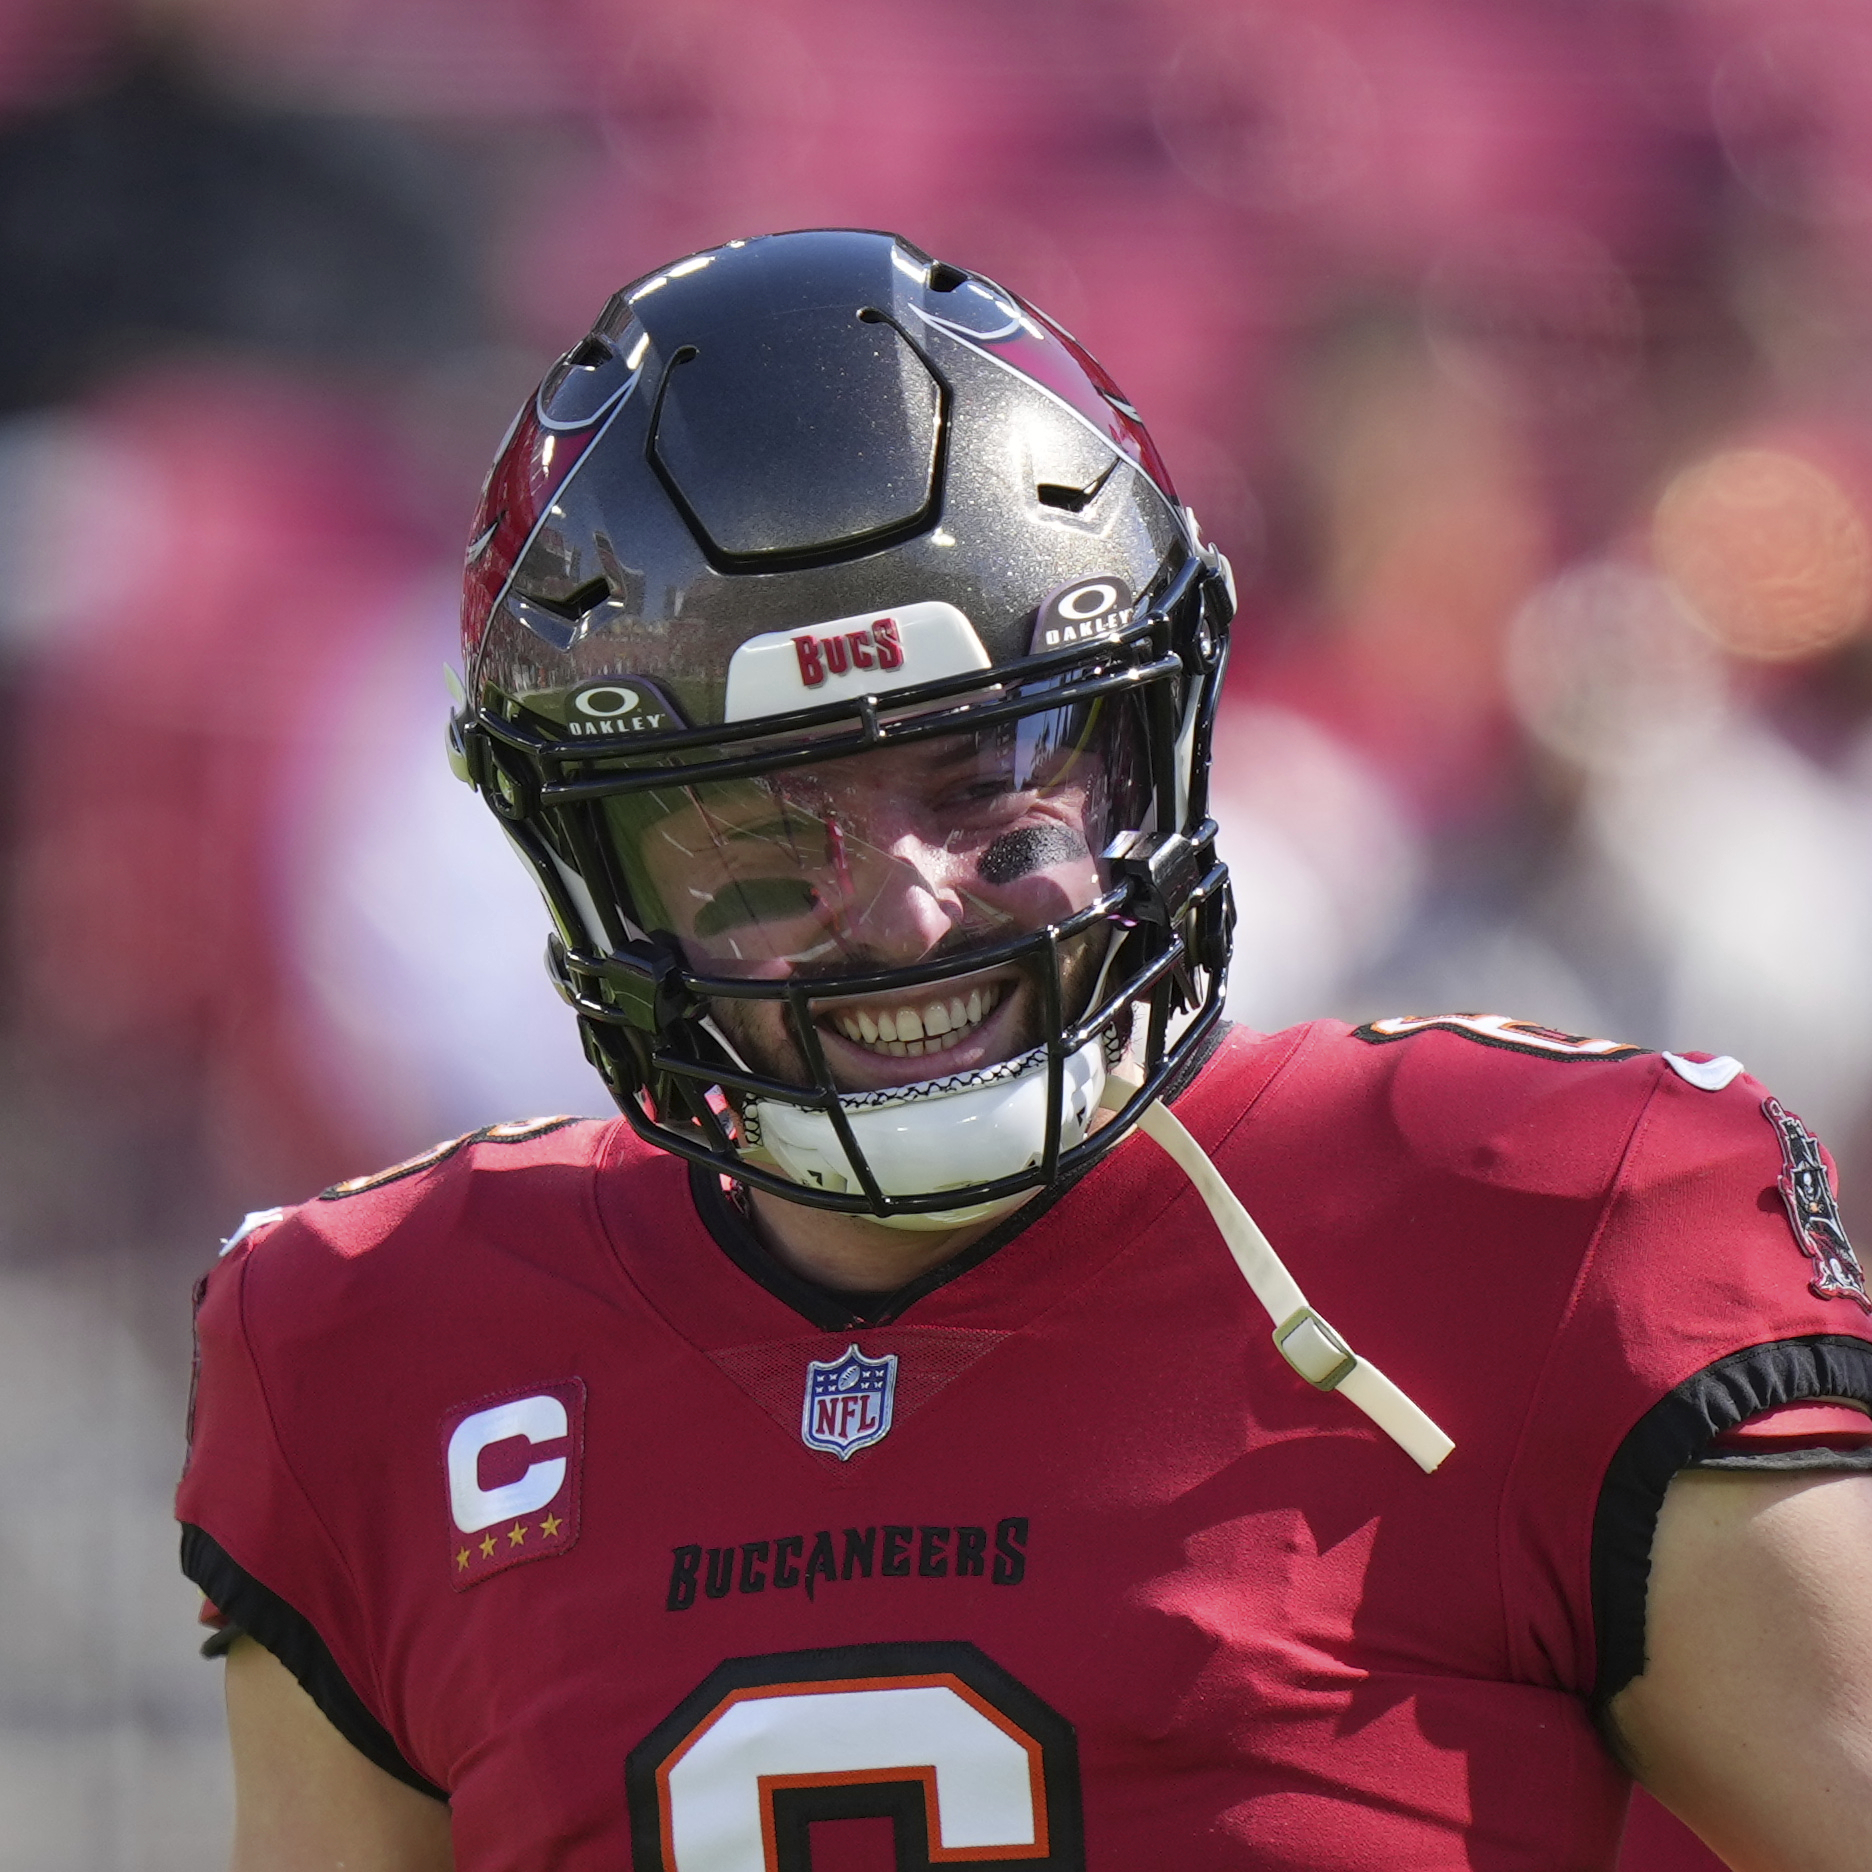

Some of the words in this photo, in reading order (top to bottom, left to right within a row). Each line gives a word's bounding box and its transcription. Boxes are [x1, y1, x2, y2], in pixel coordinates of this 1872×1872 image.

[791, 617, 905, 689] BUCS
[568, 713, 661, 736] OAKLEY
[815, 1394, 877, 1440] NFL
[446, 1394, 569, 1534] C
[666, 1516, 1030, 1612] BUCCANEERS
